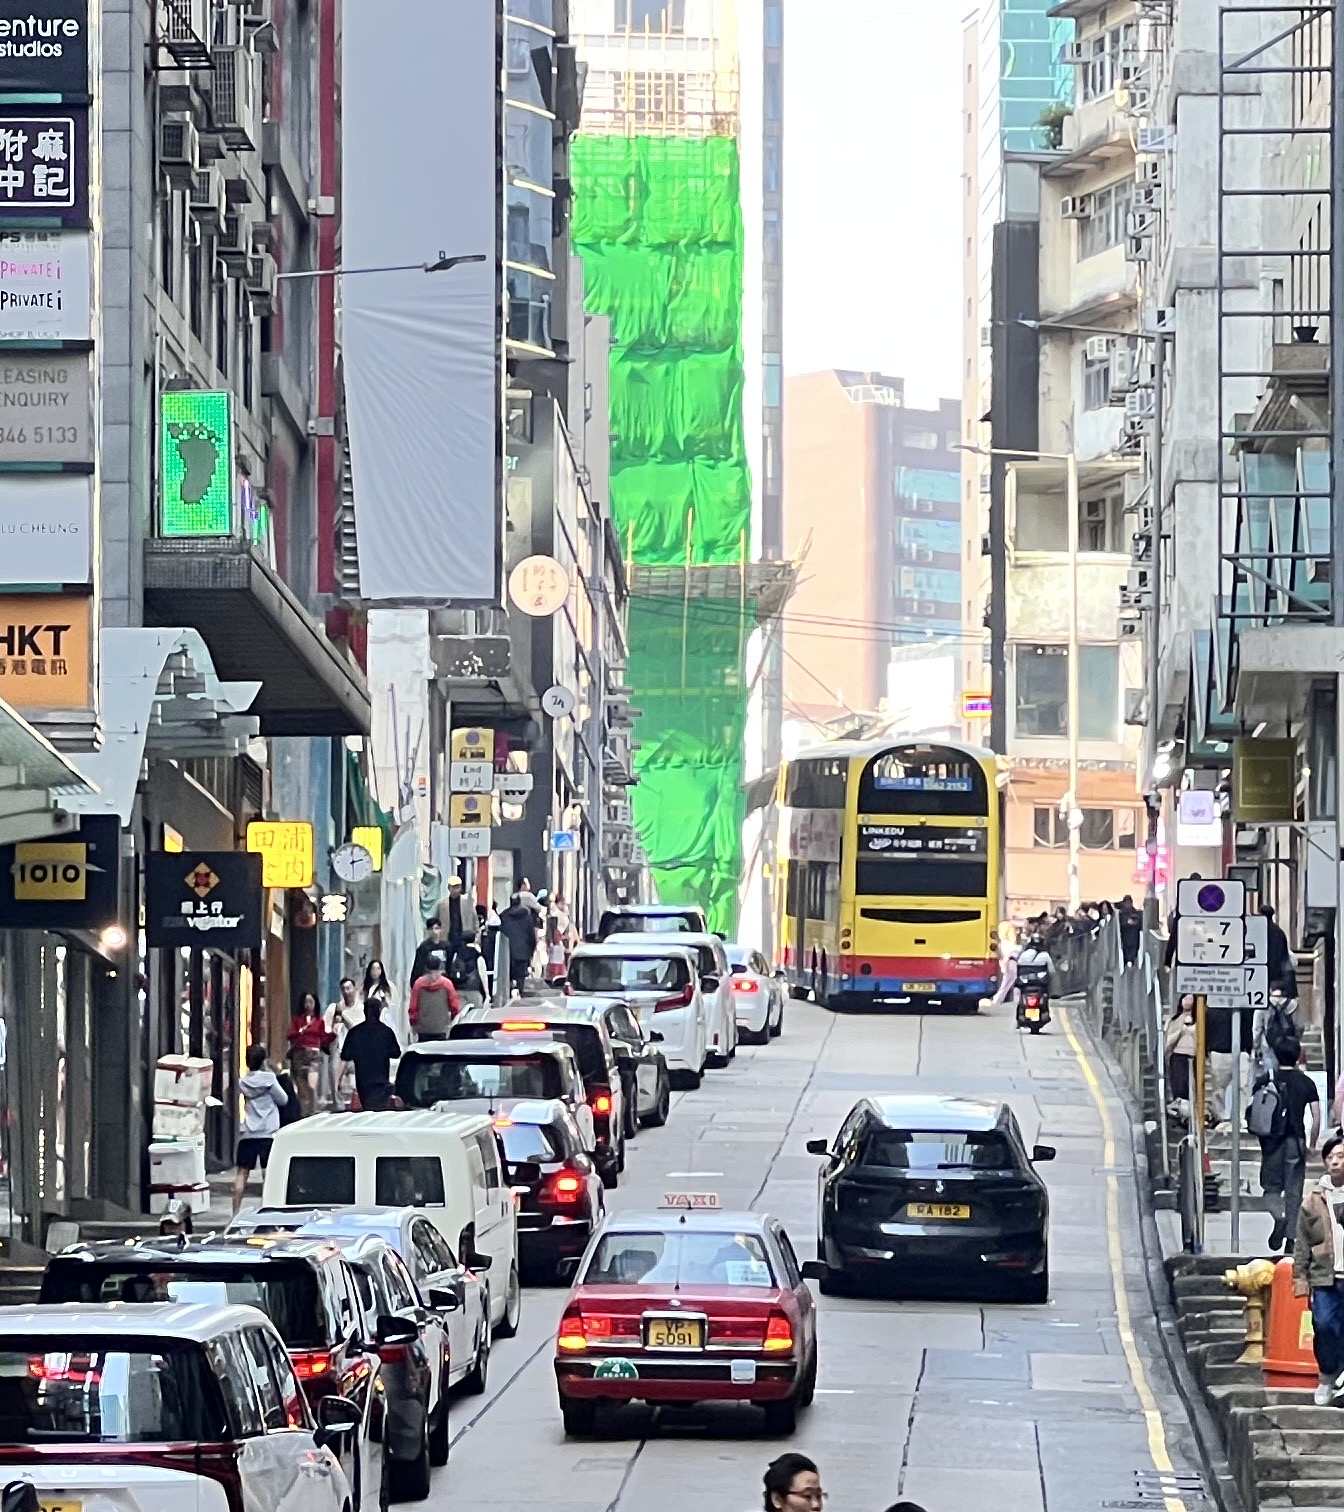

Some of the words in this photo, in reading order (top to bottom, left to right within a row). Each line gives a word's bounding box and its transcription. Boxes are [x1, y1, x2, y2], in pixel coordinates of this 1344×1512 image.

[0, 290, 54, 311] PRIVATE
[34, 426, 77, 443] 5133
[1220, 922, 1231, 935] 7
[1219, 945, 1230, 958] 7
[1247, 991, 1264, 1005] 12
[664, 1194, 716, 1206] TAXI
[656, 1333, 692, 1345] 5091
